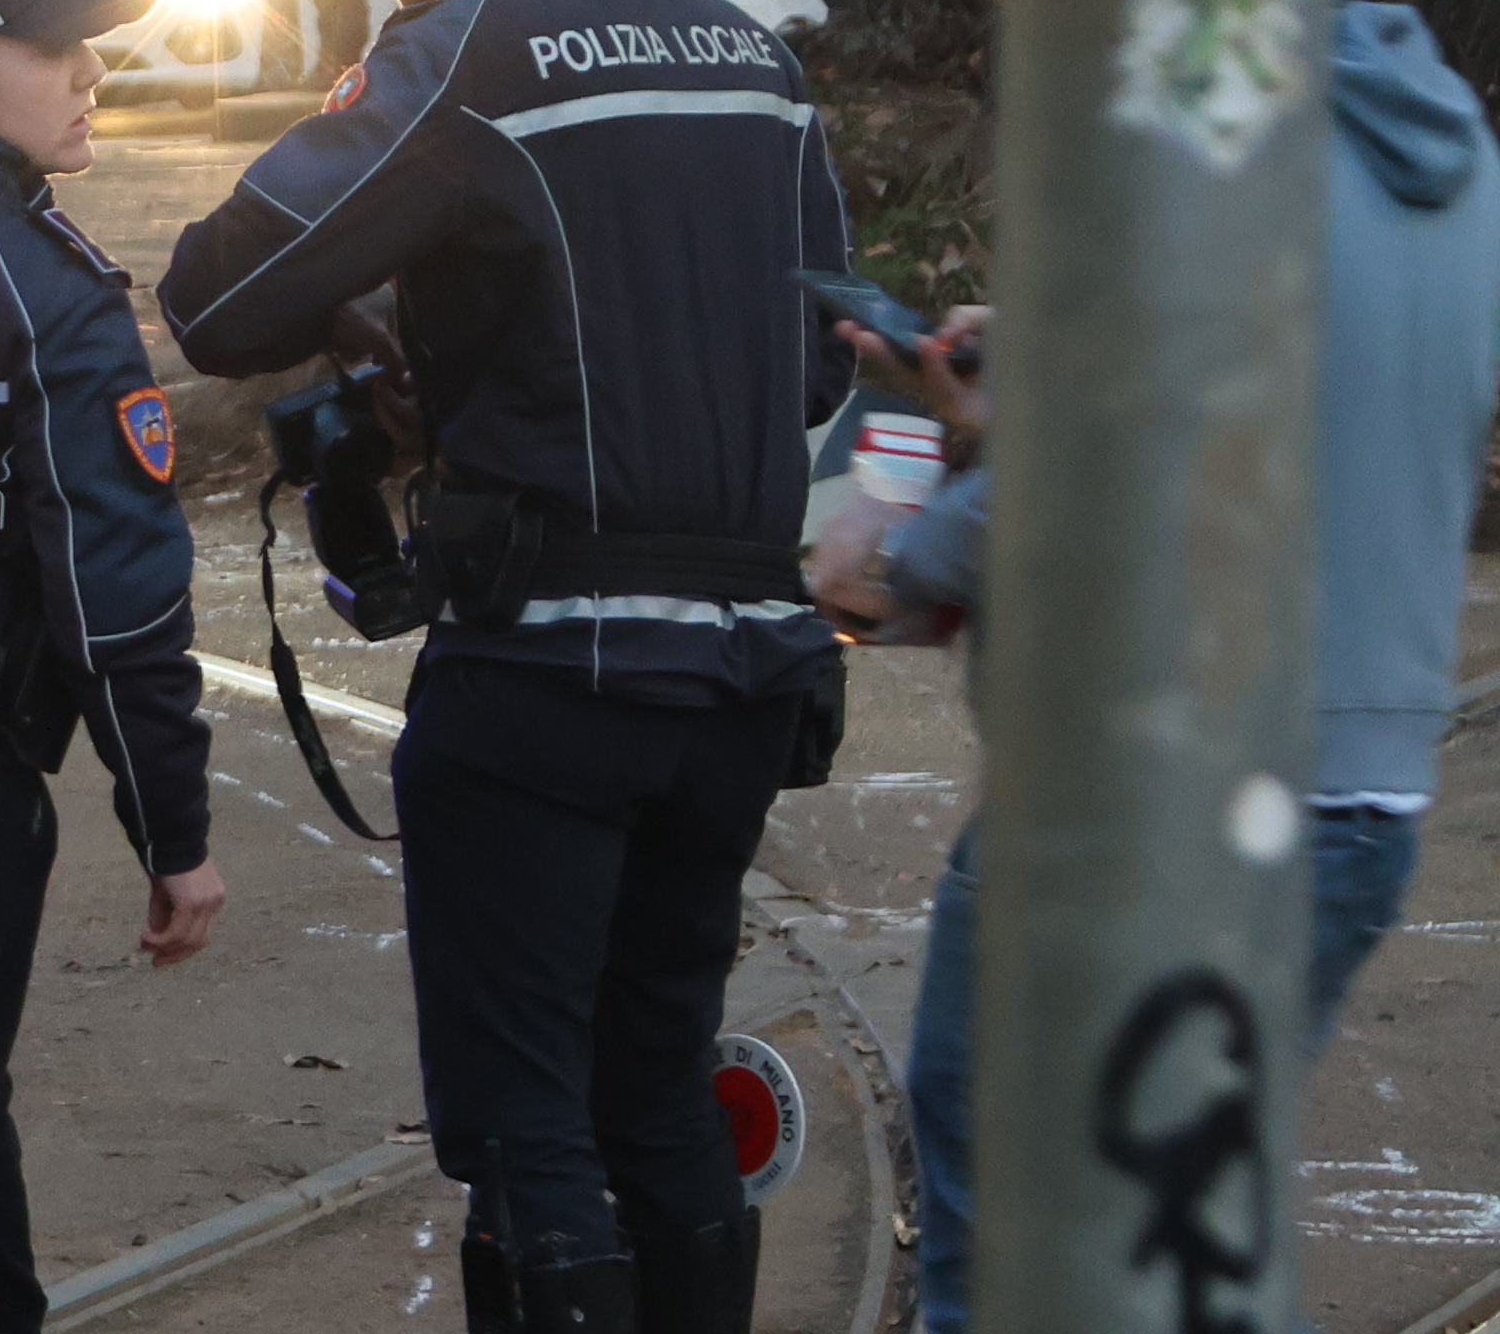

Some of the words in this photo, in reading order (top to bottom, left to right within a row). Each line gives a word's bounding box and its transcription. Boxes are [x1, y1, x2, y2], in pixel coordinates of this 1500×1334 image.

[527, 23, 677, 81] POLIZIA
[672, 24, 781, 69] LOCALE
[759, 1060, 795, 1143] MILANO
